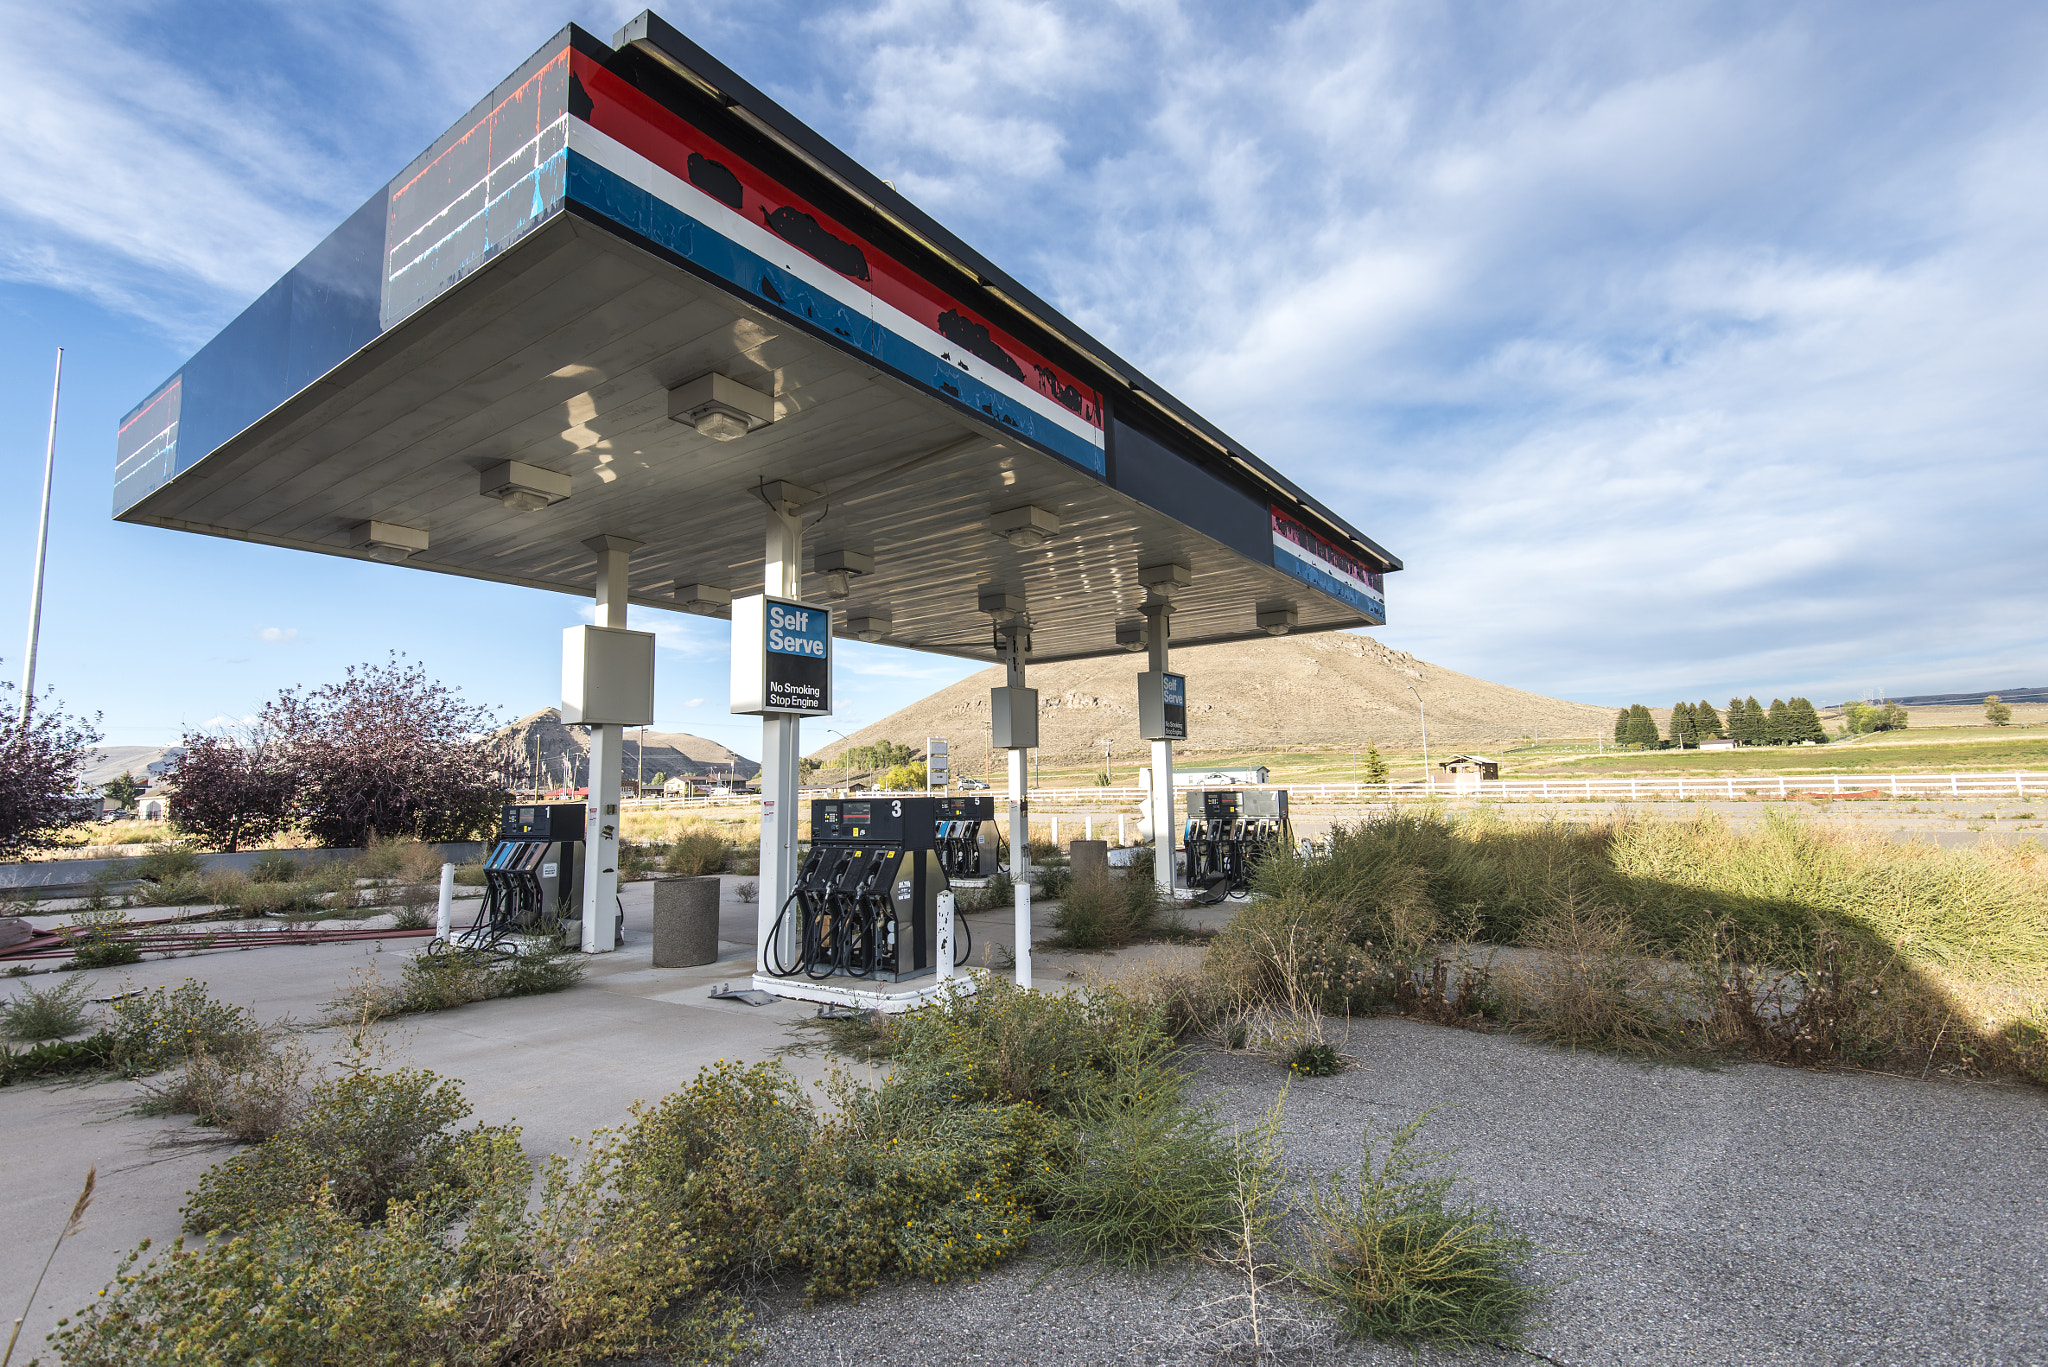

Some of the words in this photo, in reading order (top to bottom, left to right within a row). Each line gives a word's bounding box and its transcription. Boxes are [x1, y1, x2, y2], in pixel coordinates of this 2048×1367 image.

[770, 606, 808, 633] Self
[769, 628, 824, 655] Serve
[770, 681, 783, 693] No
[784, 682, 820, 698] Smoking
[1163, 677, 1177, 691] Self
[770, 693, 790, 707] Stop
[791, 696, 819, 709] Engine
[1163, 690, 1183, 704] Serve
[974, 797, 980, 806] 5
[1269, 791, 1277, 800] 7
[545, 806, 550, 818] 1
[891, 799, 902, 818] 3
